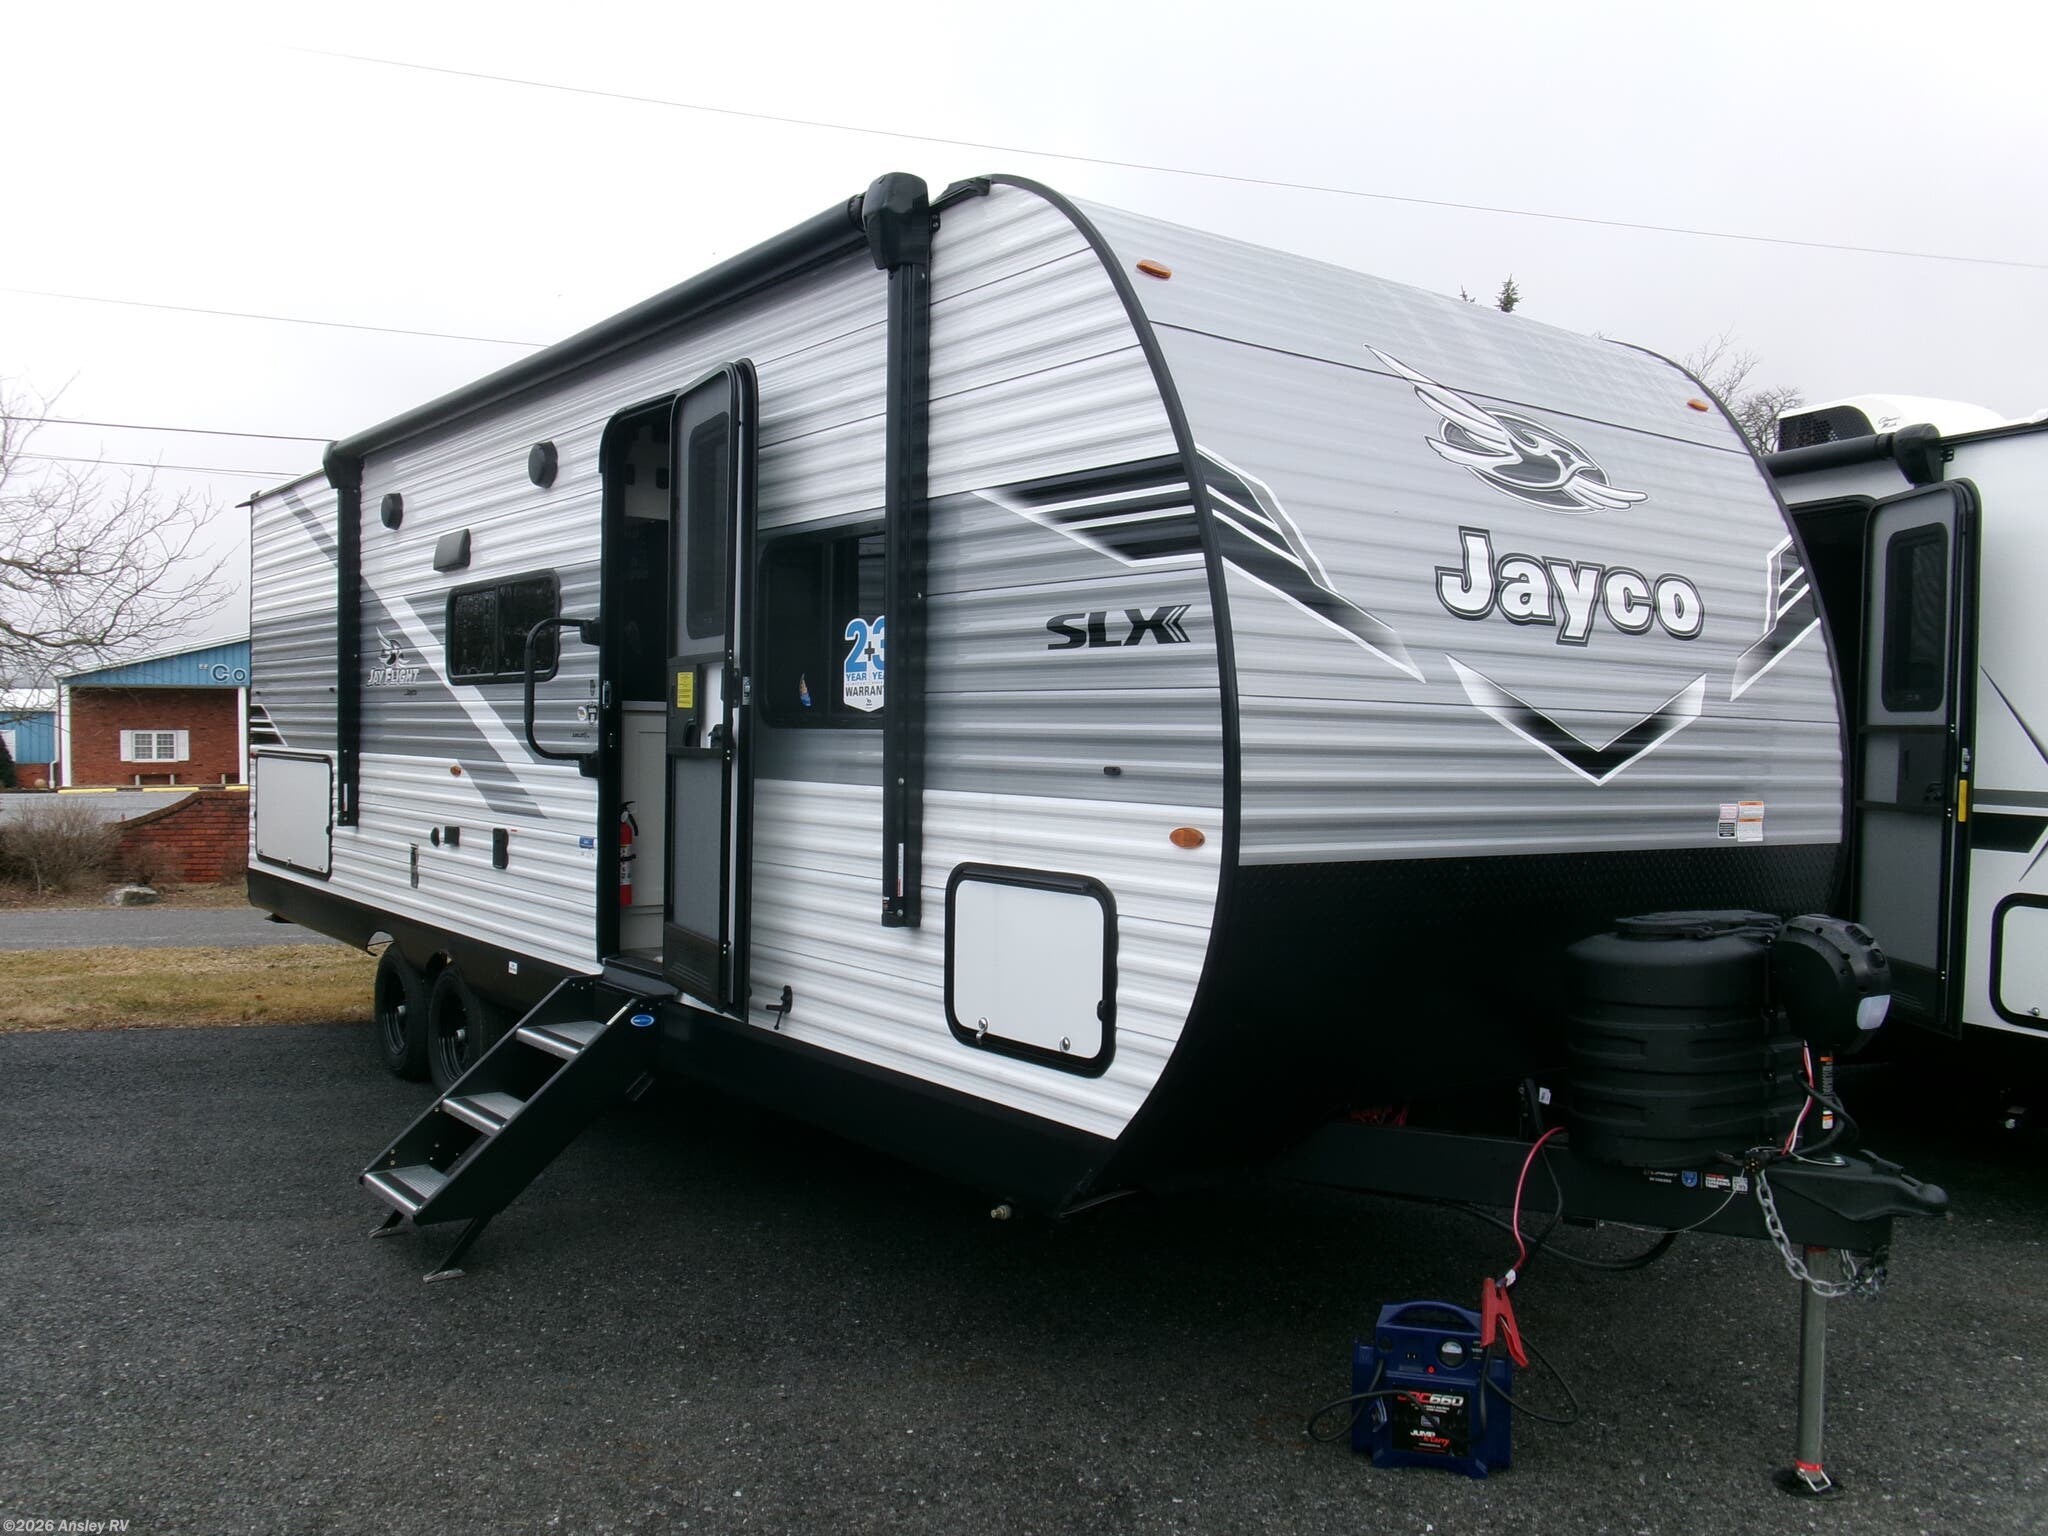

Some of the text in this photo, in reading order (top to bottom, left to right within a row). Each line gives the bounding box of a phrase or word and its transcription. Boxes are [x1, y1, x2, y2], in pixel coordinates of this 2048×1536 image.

[1434, 525, 1704, 647] Jayco
[1046, 604, 1192, 650] SLX
[367, 667, 420, 686] JAY FLIGHT
[846, 671, 884, 681] YEAR YE
[845, 685, 884, 697] WARRAN
